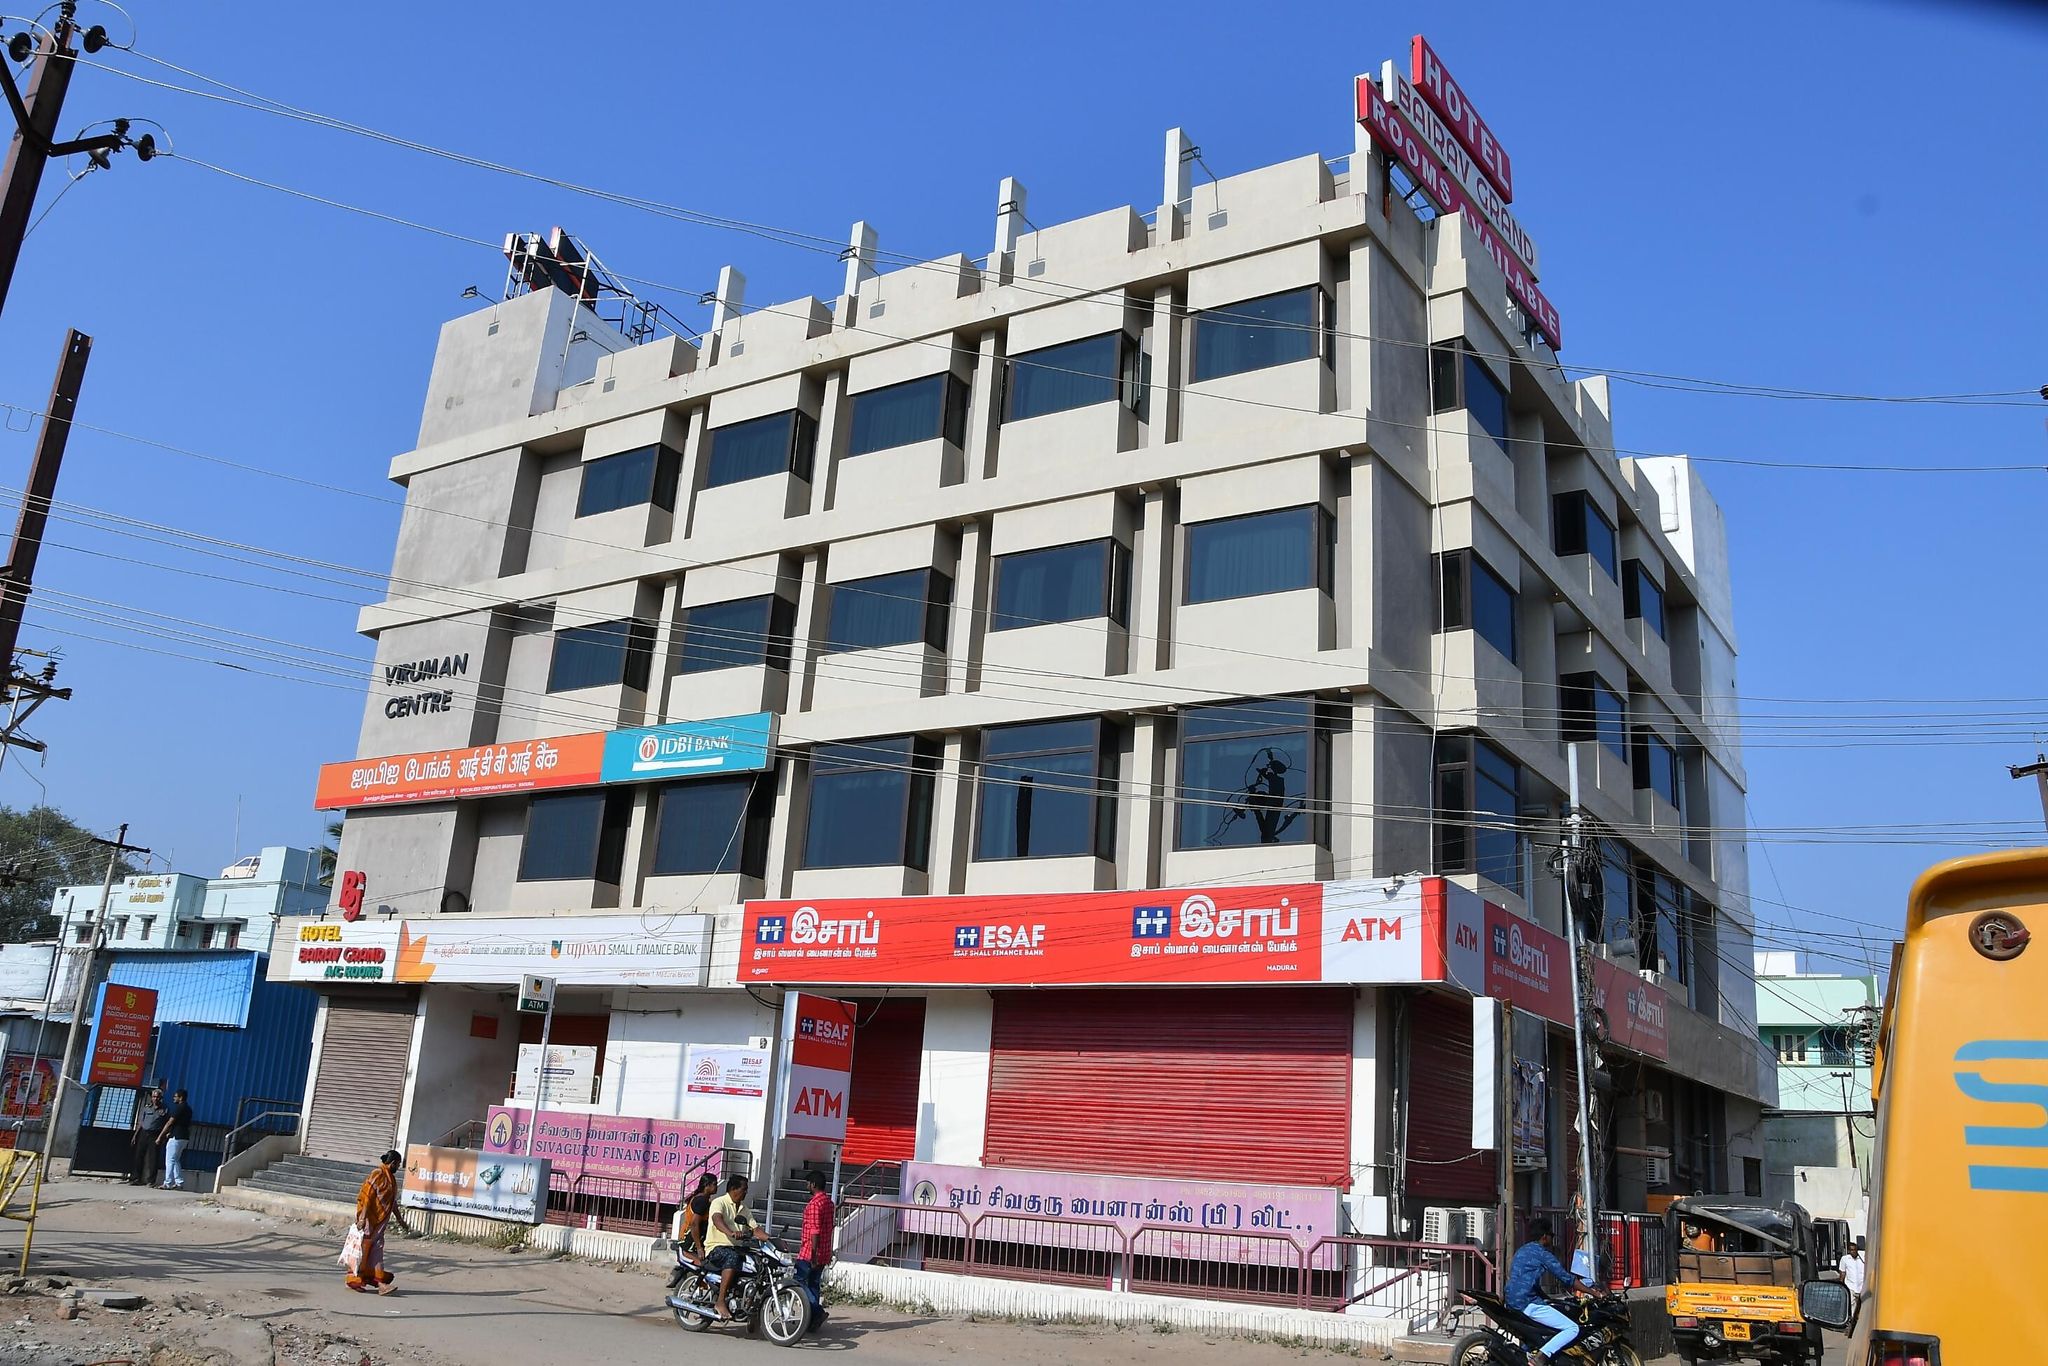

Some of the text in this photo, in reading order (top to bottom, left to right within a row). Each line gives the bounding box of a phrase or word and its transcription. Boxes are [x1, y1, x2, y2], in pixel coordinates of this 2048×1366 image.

[1424, 48, 1510, 191] HOTEL
[1396, 79, 1534, 266] BAIRAV GRAND
[1372, 94, 1559, 337] ROOMS AVAILABLE
[384, 652, 469, 687] VIRUMAN
[384, 689, 453, 719] CENTRE
[534, 741, 559, 770] बैंक
[661, 735, 729, 754] IDBI BANK
[351, 761, 400, 790] ஐடிபிஐ
[790, 906, 880, 944] இசாப்
[1179, 894, 1299, 938] இசாப்
[301, 926, 342, 941] HOTEL
[983, 924, 1045, 948] ESAF
[1340, 917, 1401, 942] ATM
[1455, 922, 1478, 953] ATM
[343, 947, 386, 964] GRAND
[608, 943, 635, 955] SMALL
[636, 943, 672, 955] FINANCE
[673, 944, 698, 955] BANK
[1130, 943, 1160, 957] இசாப்
[1164, 942, 1199, 954] ஸ்மால்
[1267, 939, 1298, 953] பேங்க்
[1510, 923, 1549, 979] இசாப்
[344, 966, 383, 979] ROOMS
[528, 1000, 544, 1010] ATM
[108, 1029, 141, 1038] AVAILABLE
[115, 1023, 137, 1031] ROOMS
[815, 1019, 850, 1041] ESAF
[102, 1039, 142, 1049] RECEPTION
[113, 1047, 145, 1057] PARKING
[793, 1086, 843, 1119] ATM
[539, 1121, 583, 1141] சிவகுரு
[586, 1128, 657, 1145] பைனான்ஸ்
[535, 1140, 599, 1158] SIVAGURU
[602, 1146, 660, 1164] FINANCE
[664, 1151, 681, 1167] (P)
[418, 1167, 471, 1189] Butterfly
[465, 1202, 492, 1211] SIVAGURU
[950, 1184, 982, 1209] ஓம்
[988, 1184, 1063, 1217] சிவகுரு
[1070, 1197, 1193, 1224] பைனான்ஸ்
